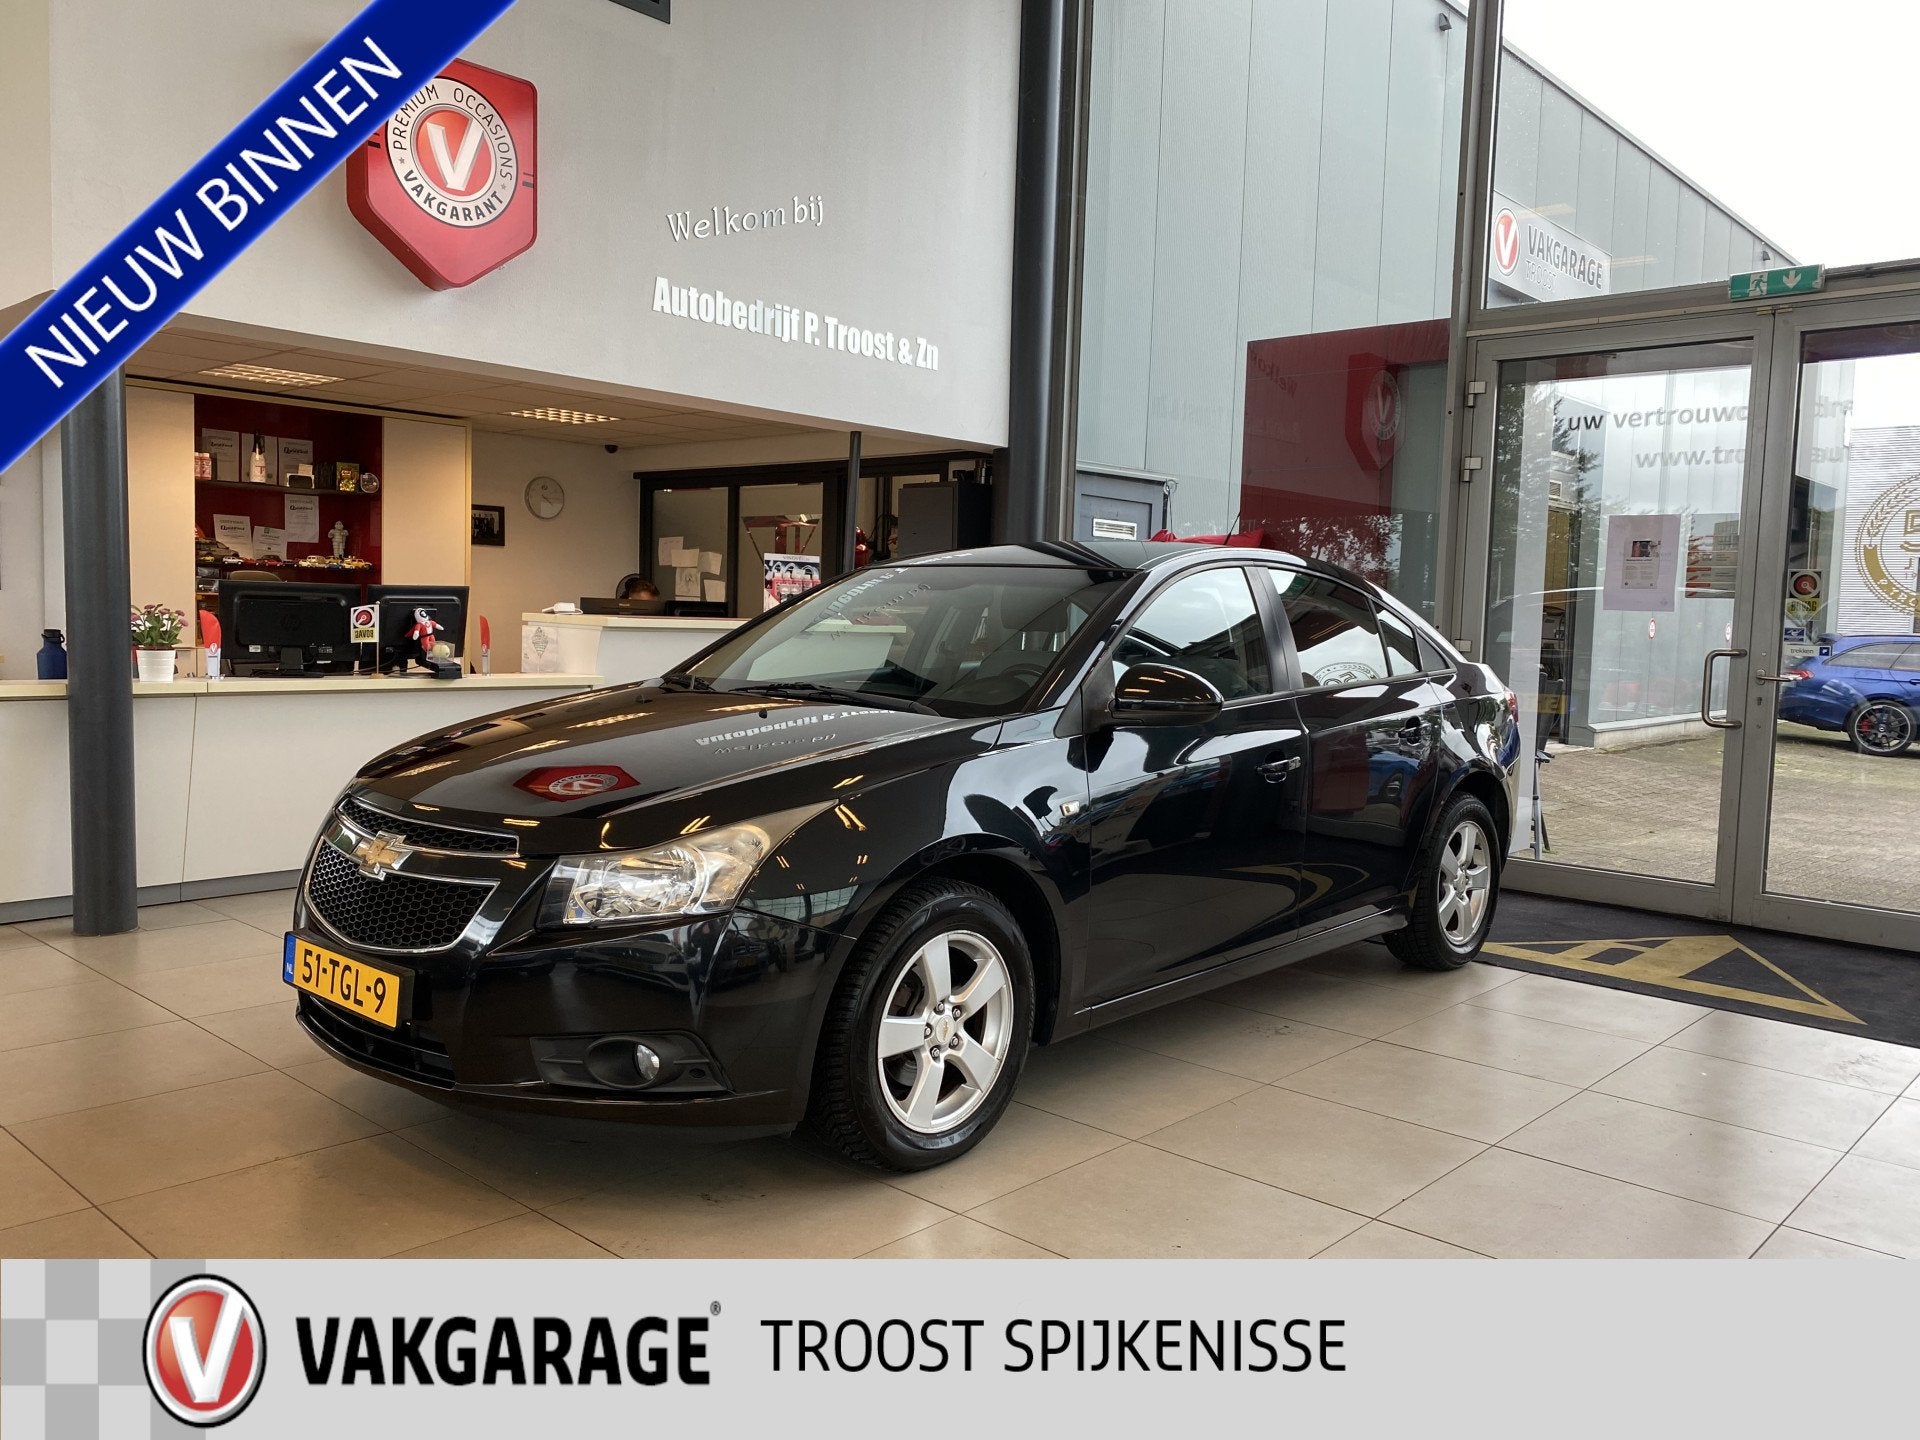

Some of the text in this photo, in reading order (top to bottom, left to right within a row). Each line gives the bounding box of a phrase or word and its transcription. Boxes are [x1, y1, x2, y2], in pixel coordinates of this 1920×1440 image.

[393, 84, 513, 182] PREMIUM OCCASIONS
[403, 170, 504, 222] VAKGARANT
[666, 195, 825, 243] Welkom bij
[1528, 225, 1603, 290] VAKGARAGE
[652, 276, 939, 371] Autobedrijf P. Troost & Zn
[1568, 412, 1604, 432] uw
[302, 948, 387, 1014] 51-TGL-9
